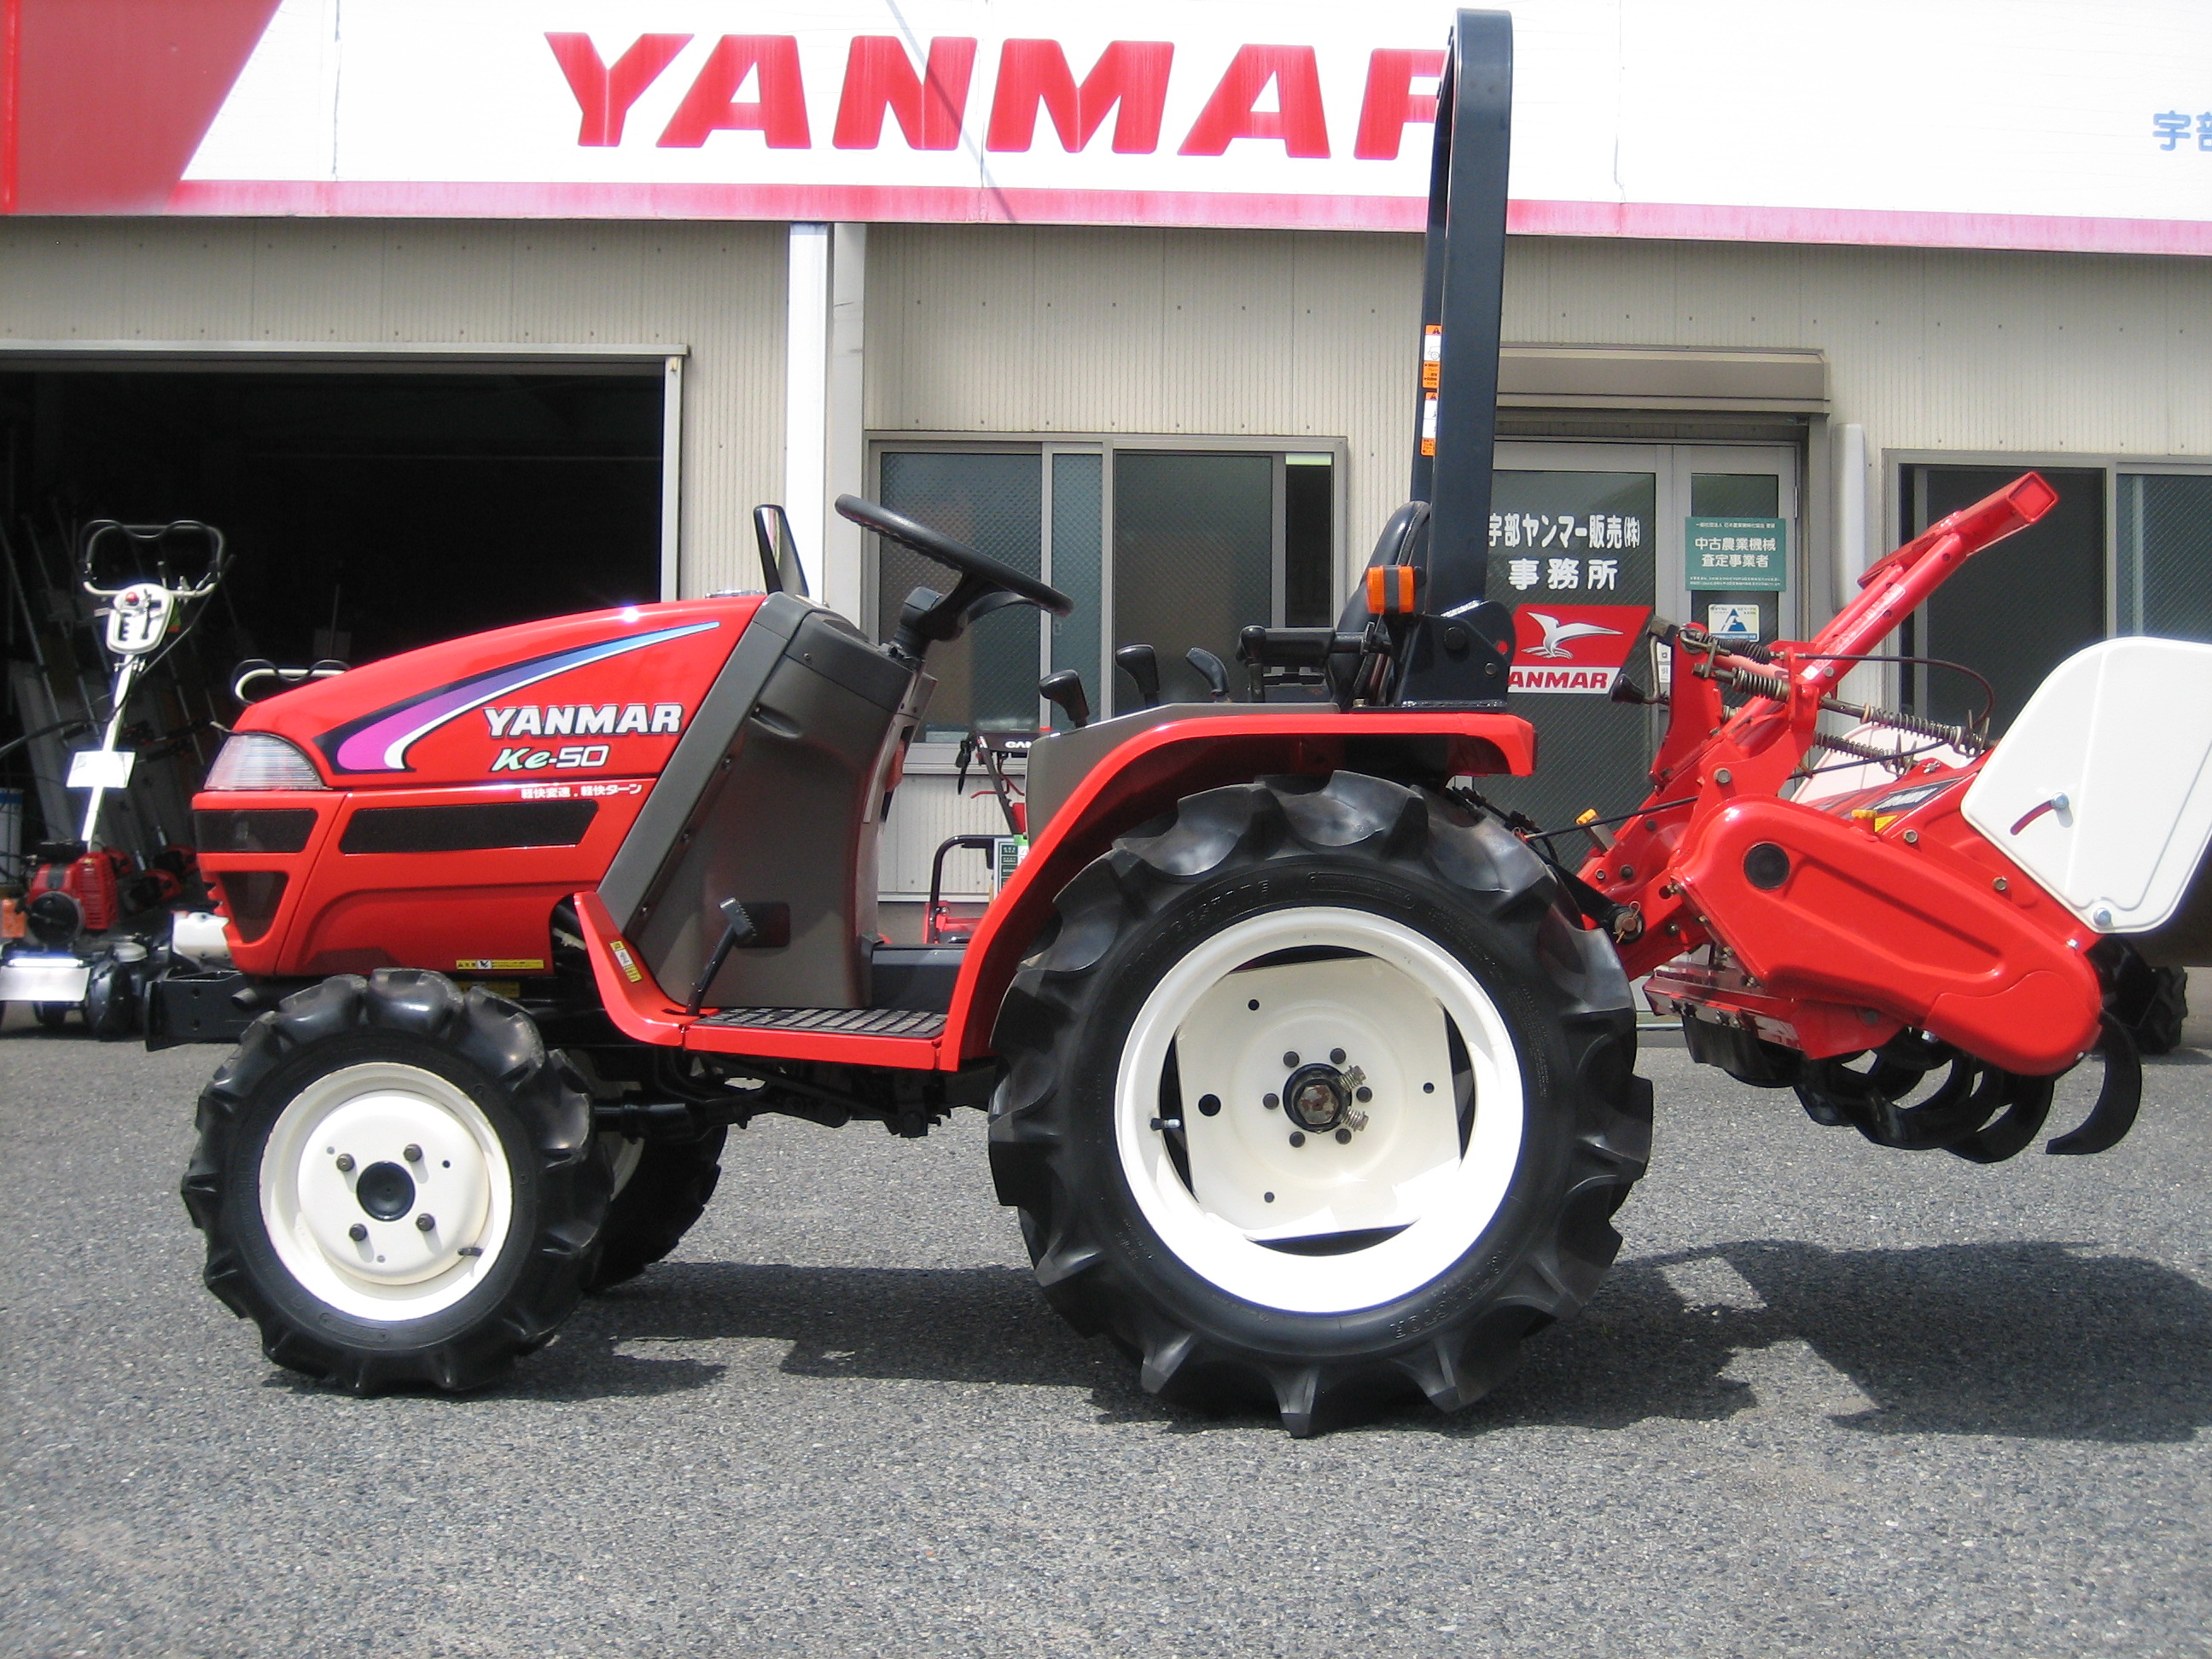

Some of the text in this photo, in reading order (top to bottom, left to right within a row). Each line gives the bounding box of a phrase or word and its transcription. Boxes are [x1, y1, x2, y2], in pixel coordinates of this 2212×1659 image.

[1695, 537, 1776, 551] 中古農業機械
[1702, 554, 1768, 568] 査定事業者
[1508, 557, 1618, 591] 事務所
[1509, 671, 1608, 689] ANMAR
[484, 703, 683, 737] YANMAR
[489, 744, 610, 771] Ke-50
